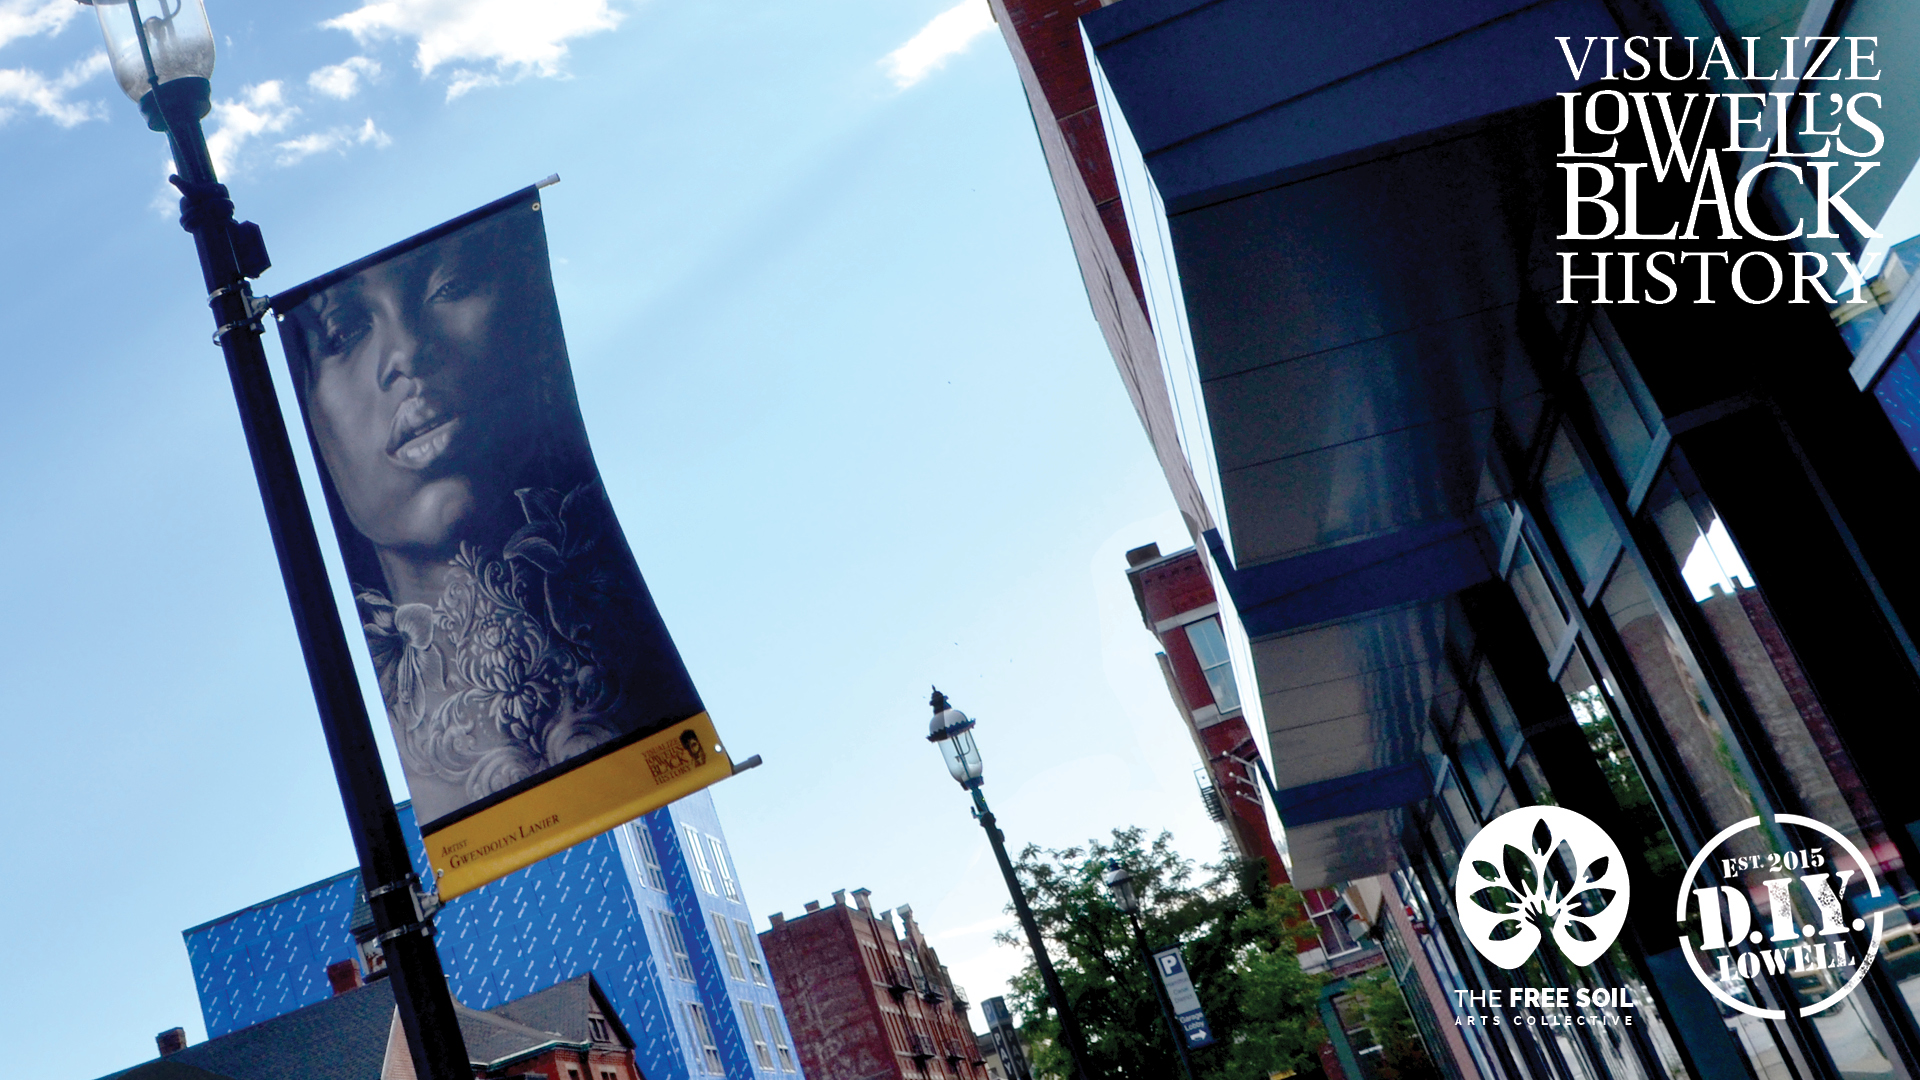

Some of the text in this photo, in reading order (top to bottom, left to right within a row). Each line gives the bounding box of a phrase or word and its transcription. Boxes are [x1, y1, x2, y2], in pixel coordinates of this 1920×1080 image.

[641, 737, 679, 758] VISUALIZE
[649, 754, 688, 778] BLACK
[654, 765, 691, 785] HISTORY
[441, 839, 468, 857] ARTIST
[449, 814, 560, 869] GWENDOLYN LANIER
[1160, 955, 1177, 975] P
[1179, 1011, 1204, 1024] Garage
[1184, 1020, 1205, 1032] Lobby
[994, 1032, 1013, 1075] PAY
[1006, 1029, 1024, 1071] PAY
